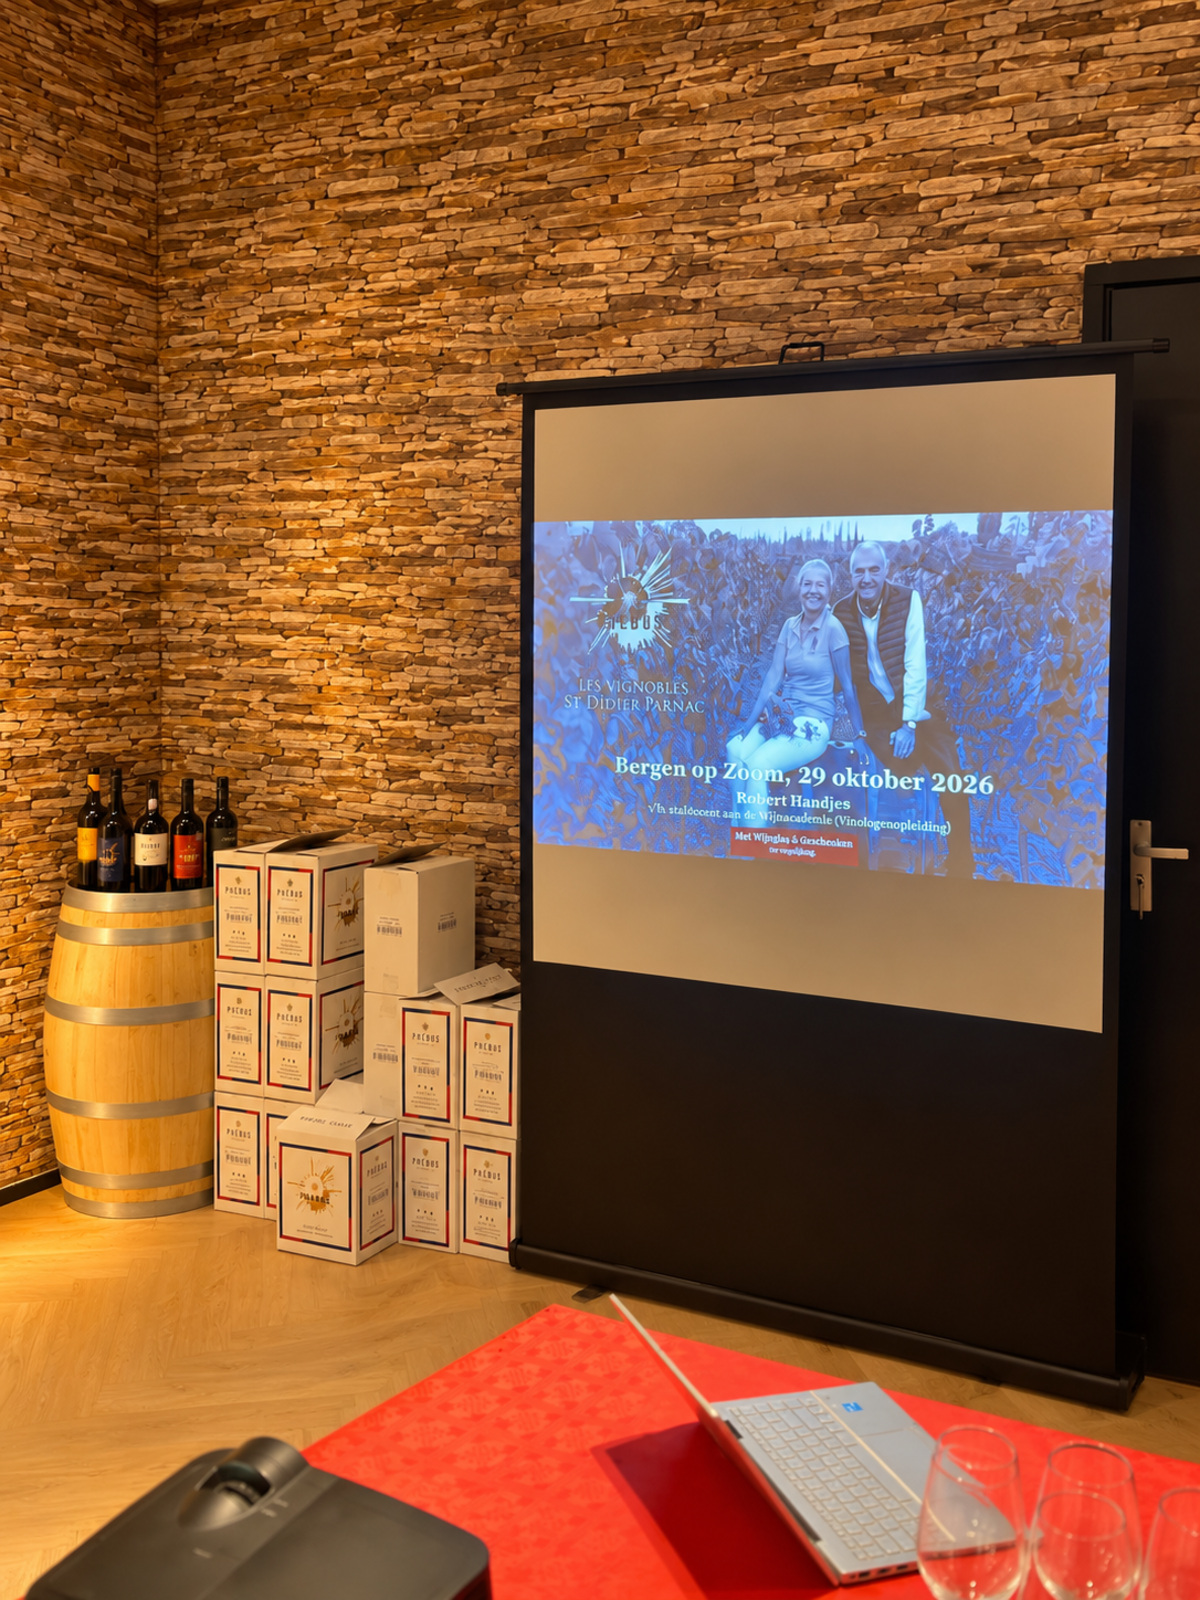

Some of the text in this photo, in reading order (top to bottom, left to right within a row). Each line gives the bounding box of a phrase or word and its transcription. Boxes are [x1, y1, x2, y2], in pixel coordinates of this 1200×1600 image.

[579, 679, 689, 696] LES VIGNOBLES
[587, 694, 641, 711] DIDIER
[645, 696, 705, 714] PARNAC
[615, 756, 995, 795] Bergen op Zoom, 29 oktober 2026
[736, 791, 851, 813] Robert Handjes
[722, 810, 741, 820] aan
[744, 810, 757, 820] de
[834, 814, 952, 836] (Vinologenopleiding)
[735, 831, 752, 841] Met
